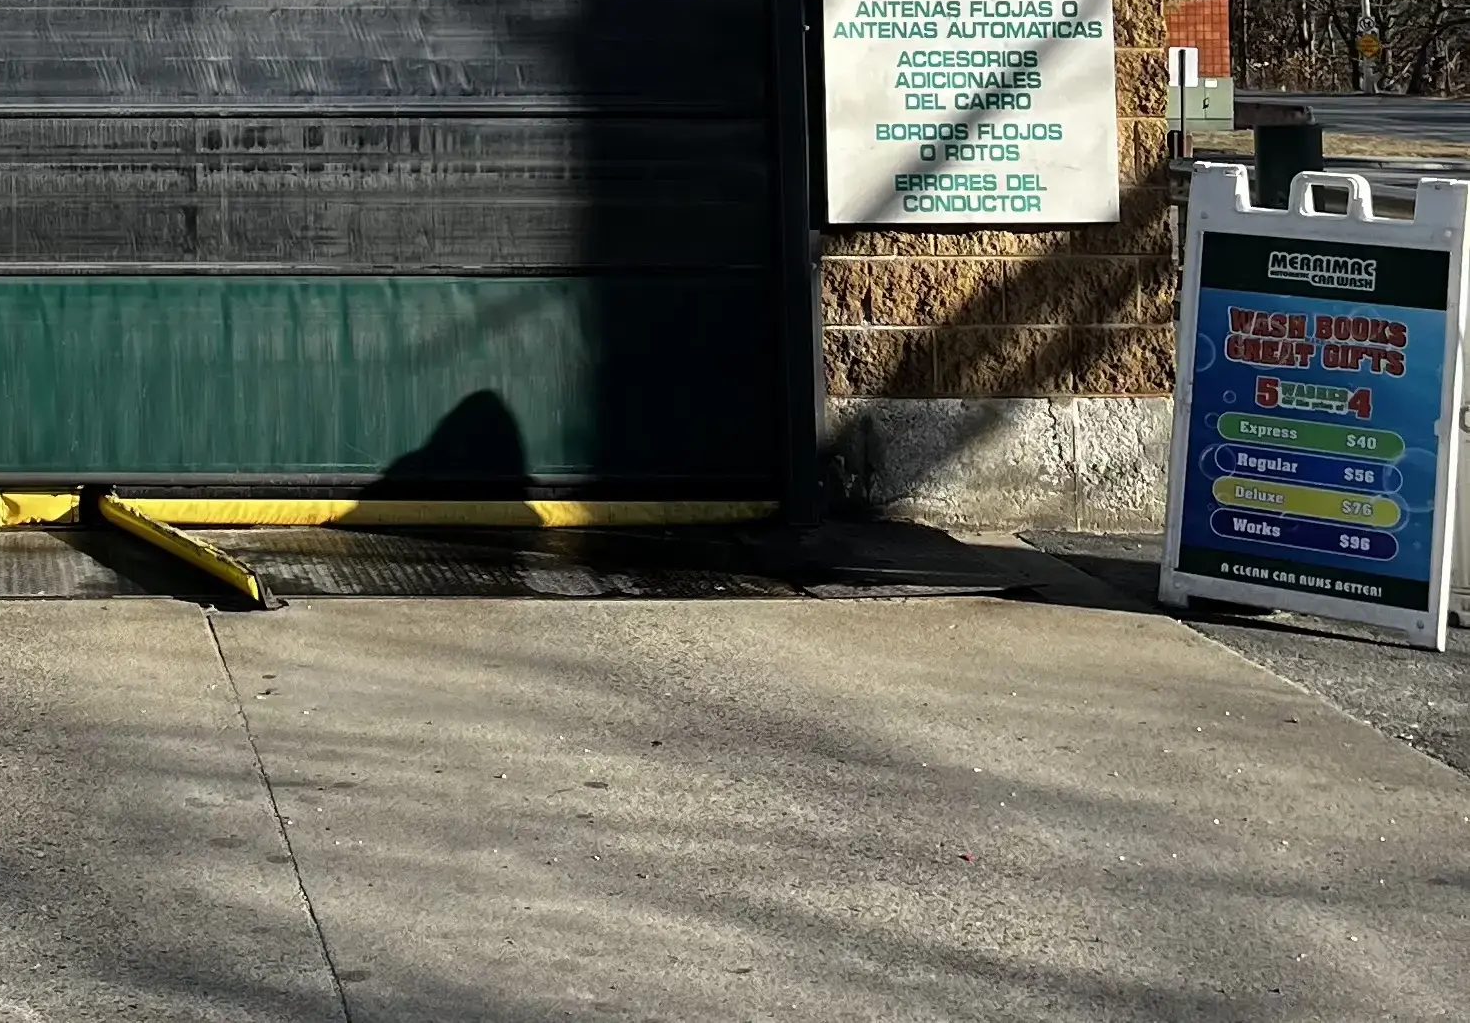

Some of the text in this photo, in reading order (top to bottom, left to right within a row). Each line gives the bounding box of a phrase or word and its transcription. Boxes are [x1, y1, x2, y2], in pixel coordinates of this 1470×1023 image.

[856, 1, 1077, 18] ANTENAS FLOJAS O
[833, 22, 1102, 39] ANTENAS AUTOMATICAS
[897, 51, 1038, 68] ACCESORIOS
[894, 72, 1041, 88] ADICIONALES
[905, 93, 1031, 110] DEL CARRO
[876, 124, 1062, 140] BORDOS FLOJOS
[920, 145, 1020, 161] O ROTOS
[895, 175, 1047, 191] ERRORES DEL
[903, 195, 1041, 212] CONDUCTOR
[1270, 253, 1375, 277] MERRIMAC
[1311, 275, 1372, 289] CAR WASH
[1228, 306, 1408, 349] WASH BOOKS
[1225, 333, 1406, 378] GREAT GIFTS
[1255, 376, 1280, 408] 5
[1348, 387, 1373, 420] 4
[1240, 421, 1377, 450] Express $40
[1237, 453, 1374, 483] Regular $56
[1235, 486, 1372, 516] Deluxe $76
[1233, 518, 1370, 551] Works $96
[1221, 563, 1382, 597] A CLEAN CAR RUNS BETTER!
